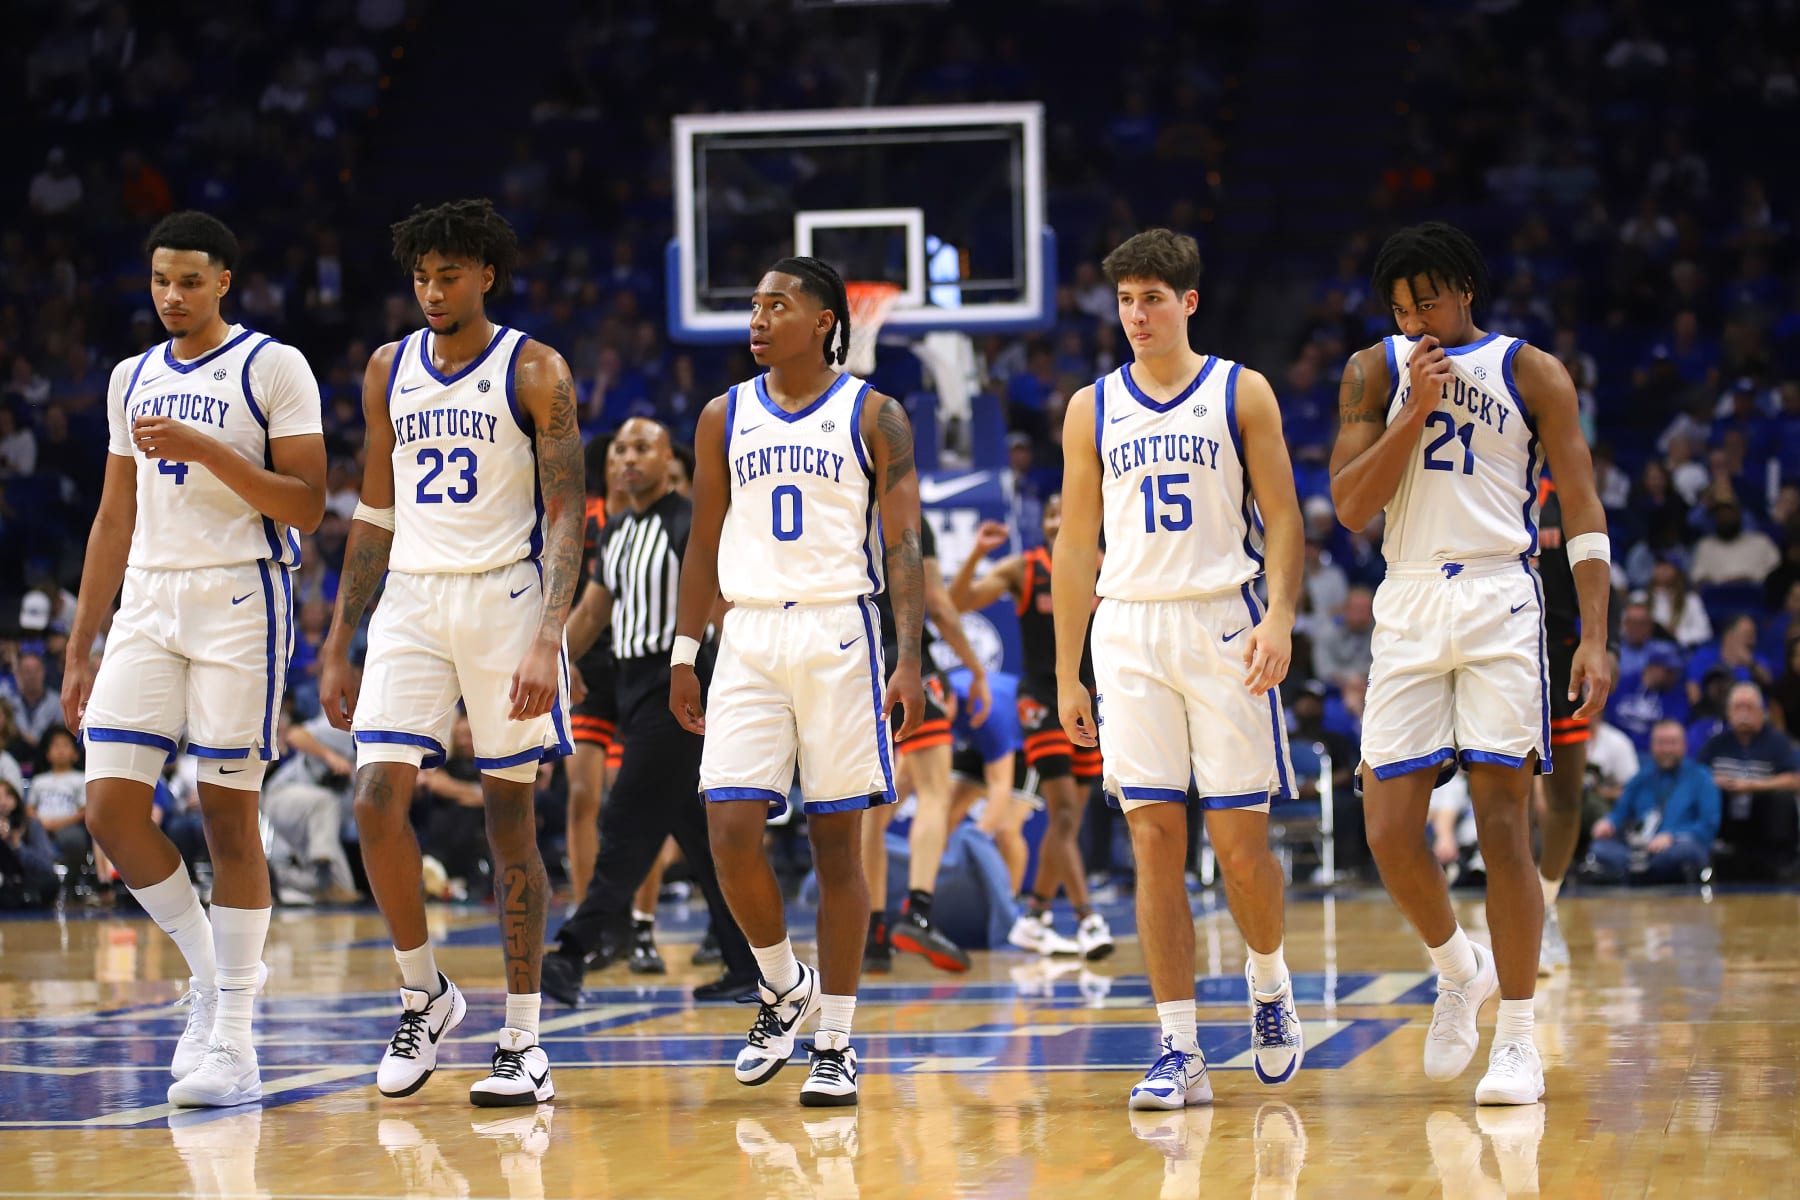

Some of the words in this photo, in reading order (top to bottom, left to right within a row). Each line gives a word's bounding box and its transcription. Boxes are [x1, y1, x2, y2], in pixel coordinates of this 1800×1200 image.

[477, 379, 491, 393] SEC
[1401, 376, 1509, 434] TUCKY
[395, 408, 498, 447] KENTUCKY
[1423, 410, 1475, 476] 21
[415, 447, 478, 504] 23
[735, 445, 845, 487] KENTUCKY
[1108, 434, 1219, 479] KENTUCKY
[771, 484, 803, 542] 0
[1139, 473, 1193, 533] 15
